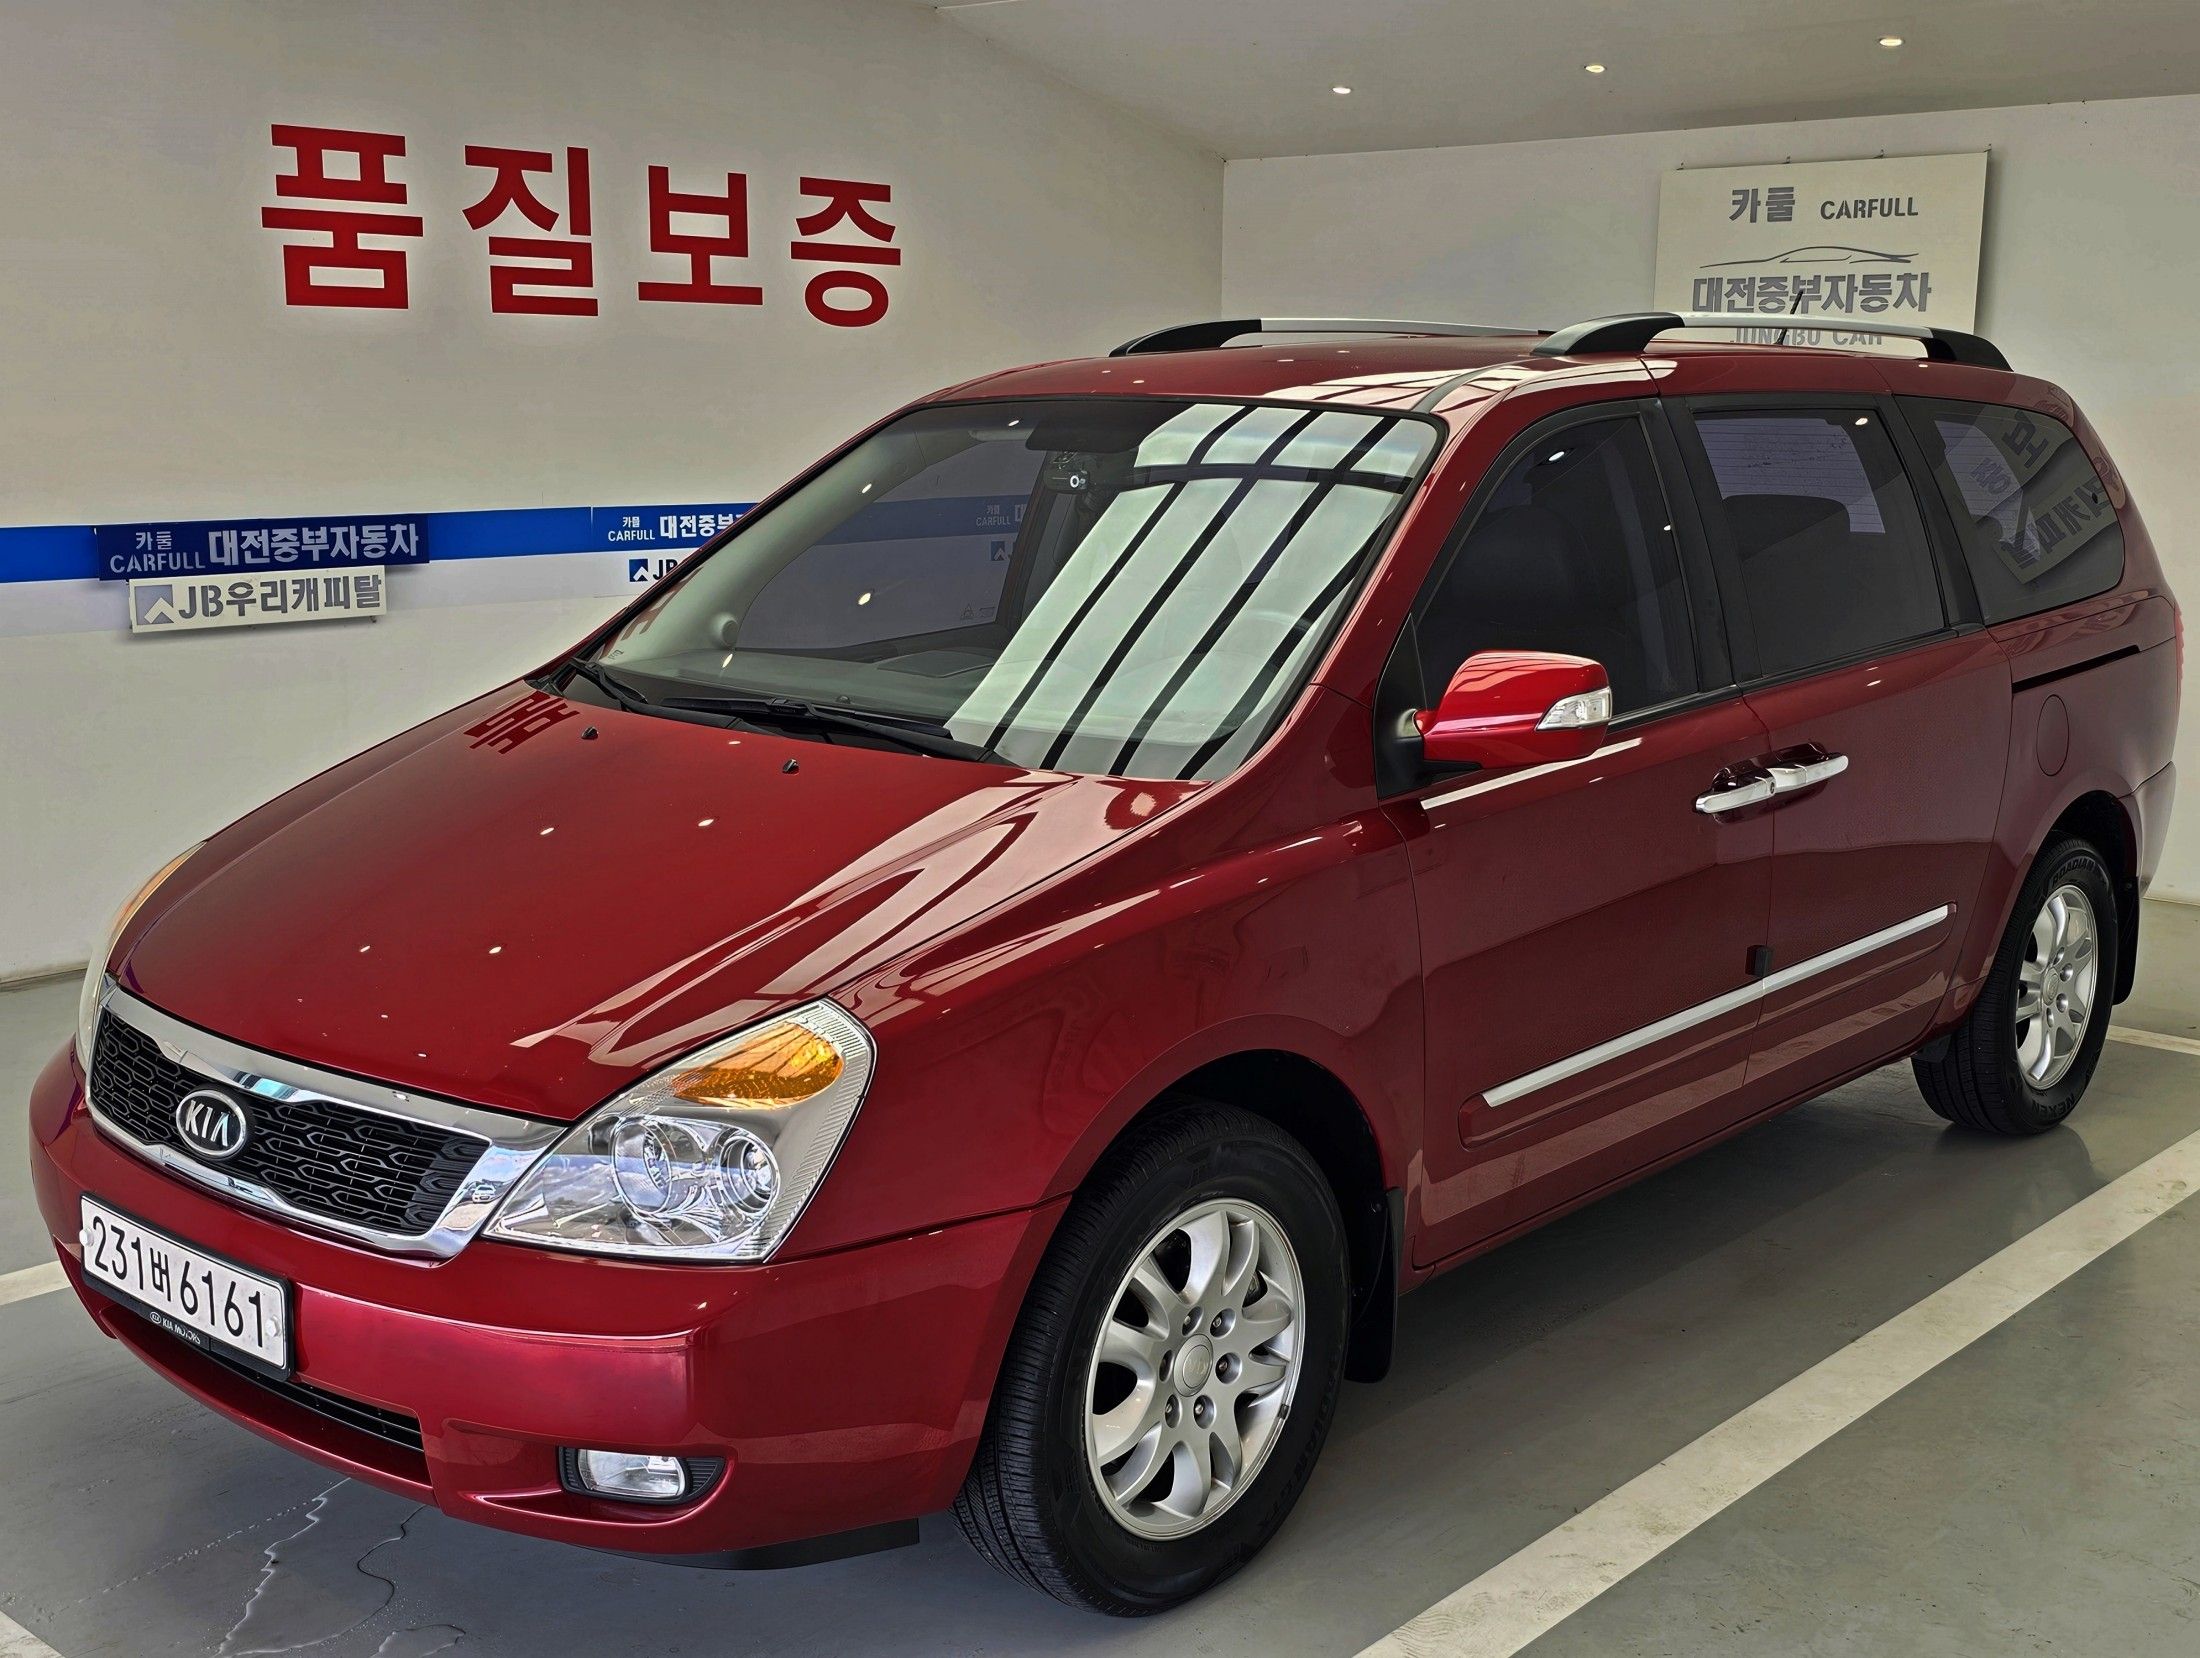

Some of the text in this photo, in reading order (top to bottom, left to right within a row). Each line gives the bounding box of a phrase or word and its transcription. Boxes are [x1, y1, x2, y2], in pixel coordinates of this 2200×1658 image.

[1820, 197, 1919, 220] CARFULL
[261, 124, 901, 327] 품질보증
[1692, 272, 1932, 314] 대전중부자동차
[608, 529, 656, 541] CARFULL
[659, 514, 744, 539] 대전중부
[976, 516, 1011, 527] CARFULL
[208, 523, 419, 567] 대전중부자동차
[109, 551, 206, 573] CARFULL
[178, 574, 382, 619] JB우리캐피탈
[185, 1099, 229, 1147] KIA
[92, 1215, 263, 1348] 231버6161
[162, 1316, 174, 1331] KIA
